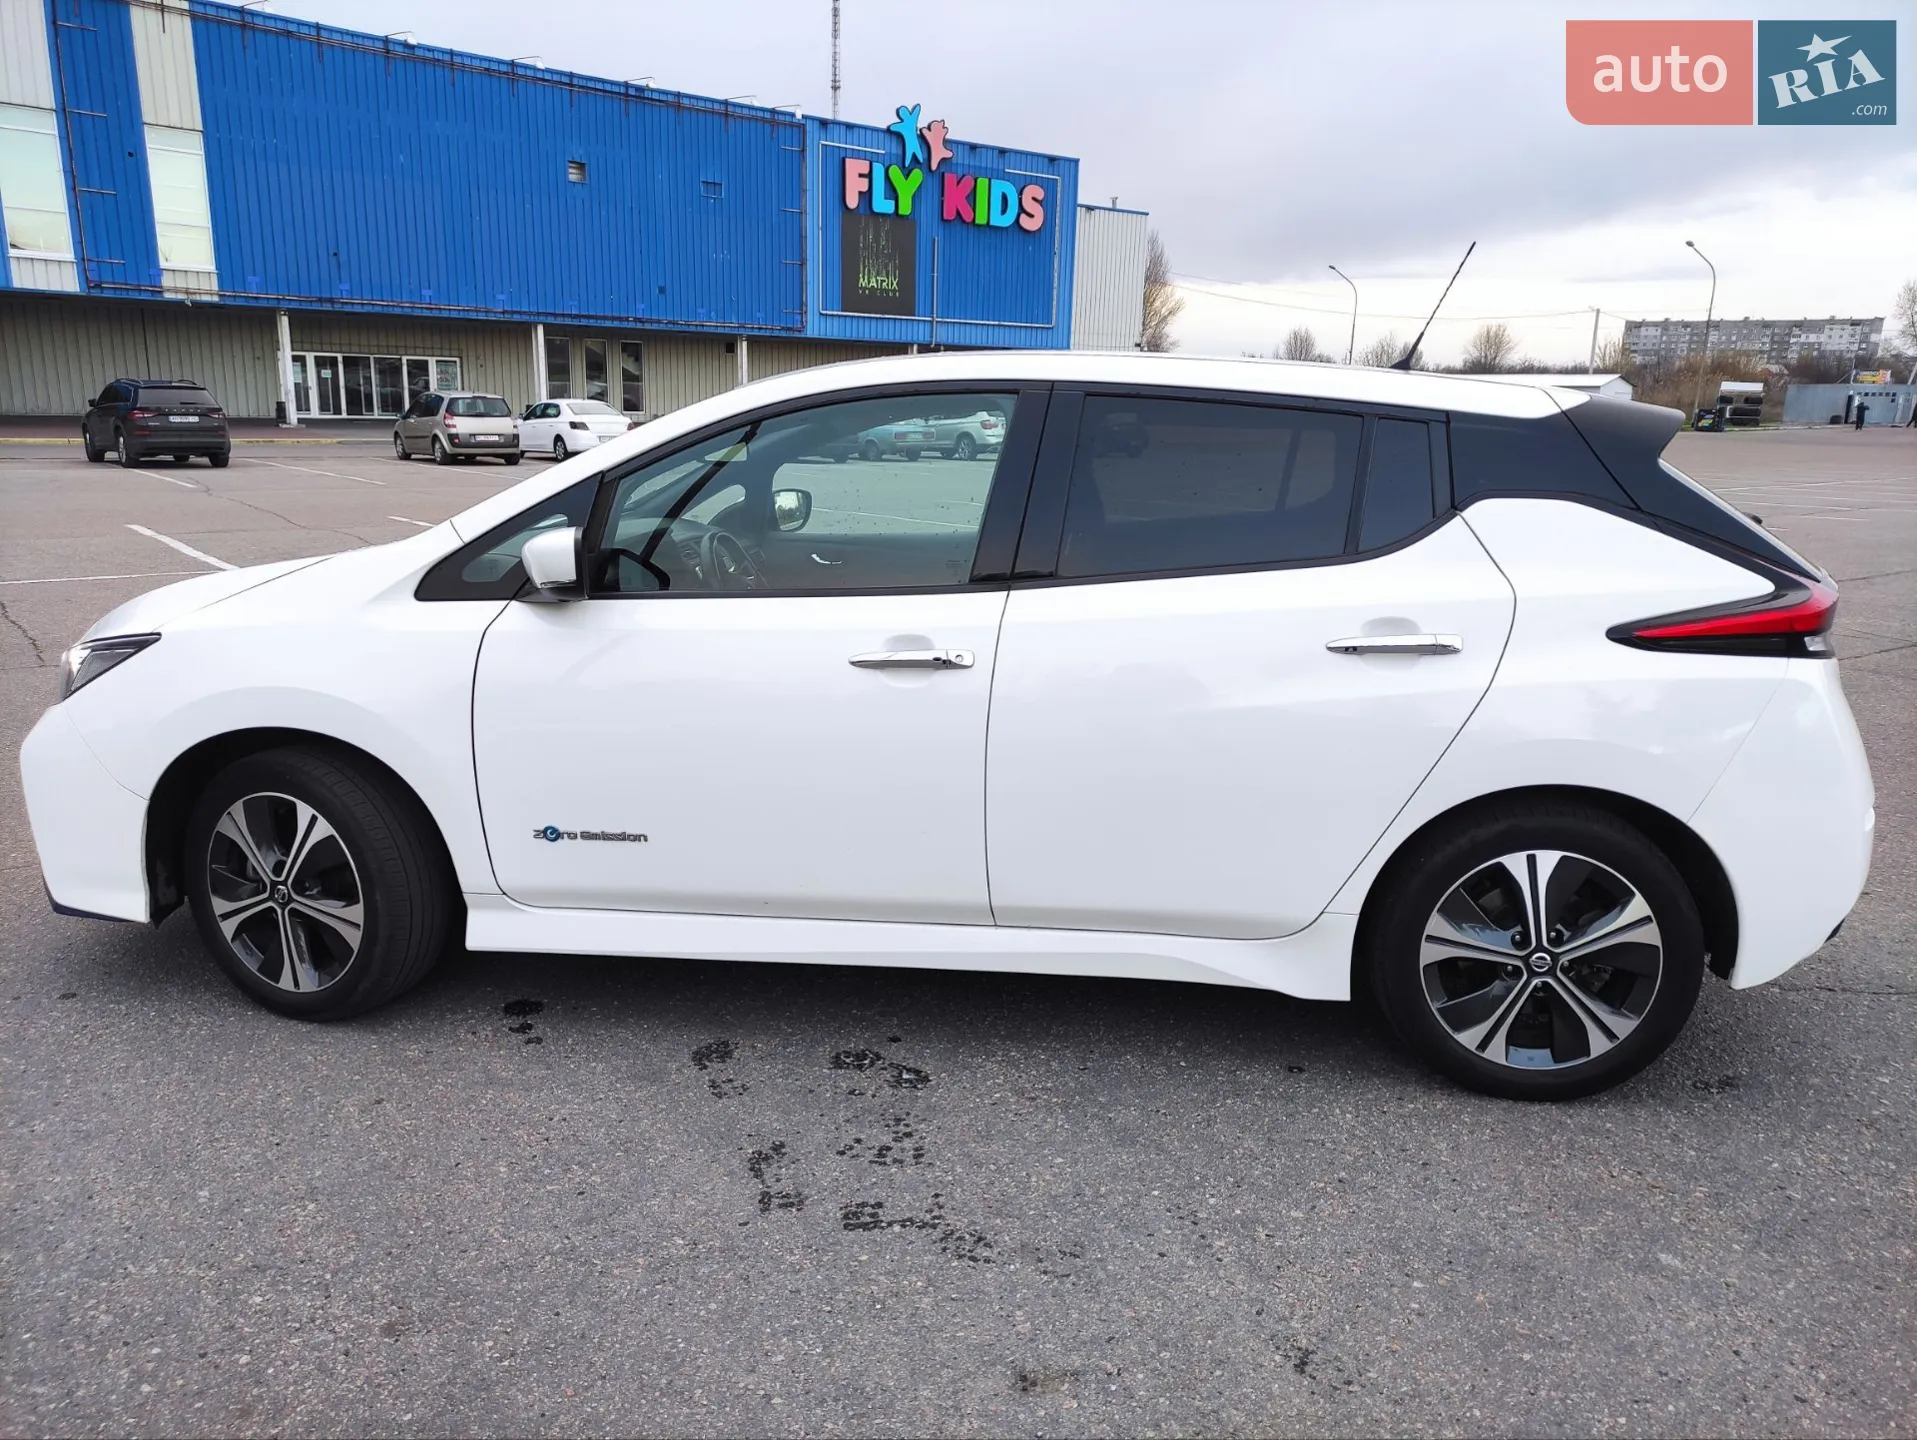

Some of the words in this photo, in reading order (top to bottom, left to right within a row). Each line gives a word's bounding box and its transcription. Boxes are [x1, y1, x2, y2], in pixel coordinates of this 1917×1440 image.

[844, 157, 924, 216] FLY
[943, 172, 1046, 232] KIDS
[858, 275, 899, 290] MATRIX
